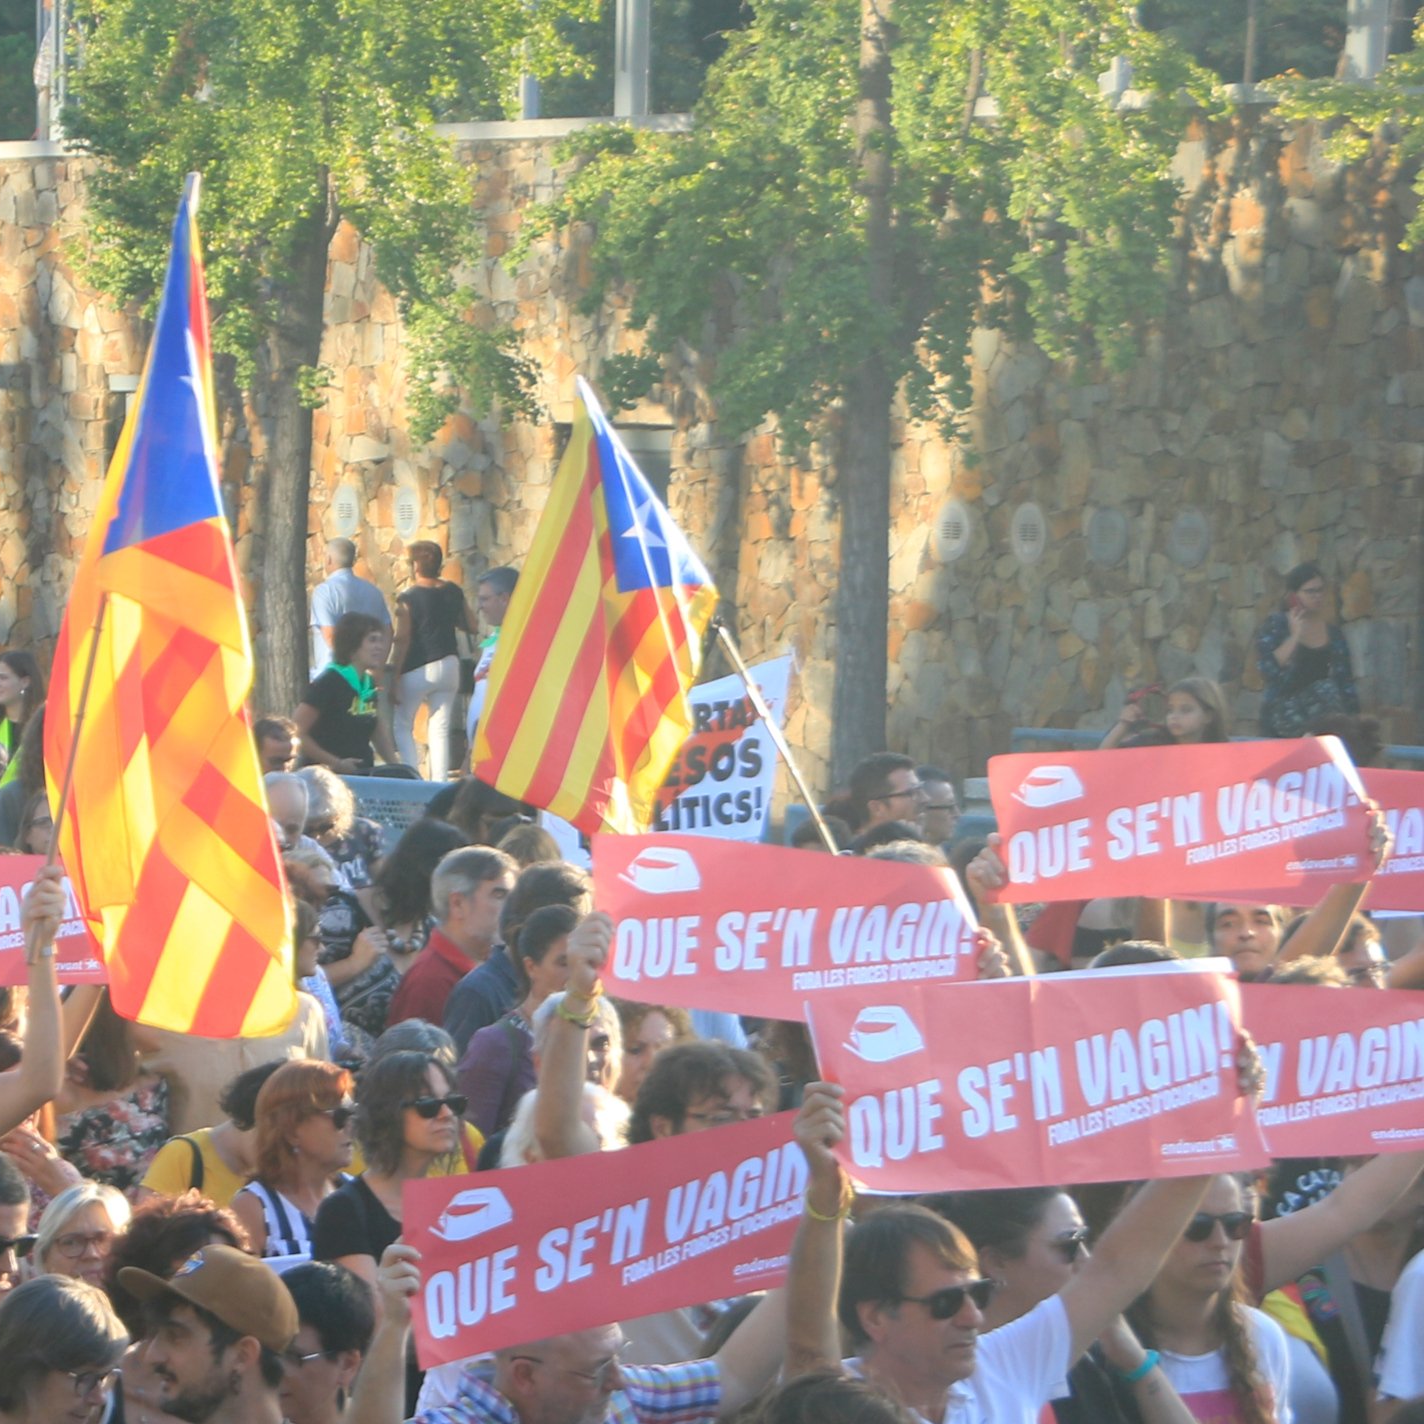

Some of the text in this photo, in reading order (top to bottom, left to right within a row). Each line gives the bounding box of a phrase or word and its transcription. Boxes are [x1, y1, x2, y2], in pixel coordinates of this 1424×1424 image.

[1008, 817, 1093, 885] QUE
[1107, 791, 1203, 861] SE'N
[613, 915, 701, 982] QUE
[715, 907, 818, 972] SE'N
[849, 1078, 946, 1168] QUE
[957, 1046, 1064, 1138] SE'N
[1075, 1000, 1233, 1107] VAGIN!
[1297, 1017, 1424, 1097] VAGIN
[425, 1140, 809, 1340] QUE SE'N VAGIN
